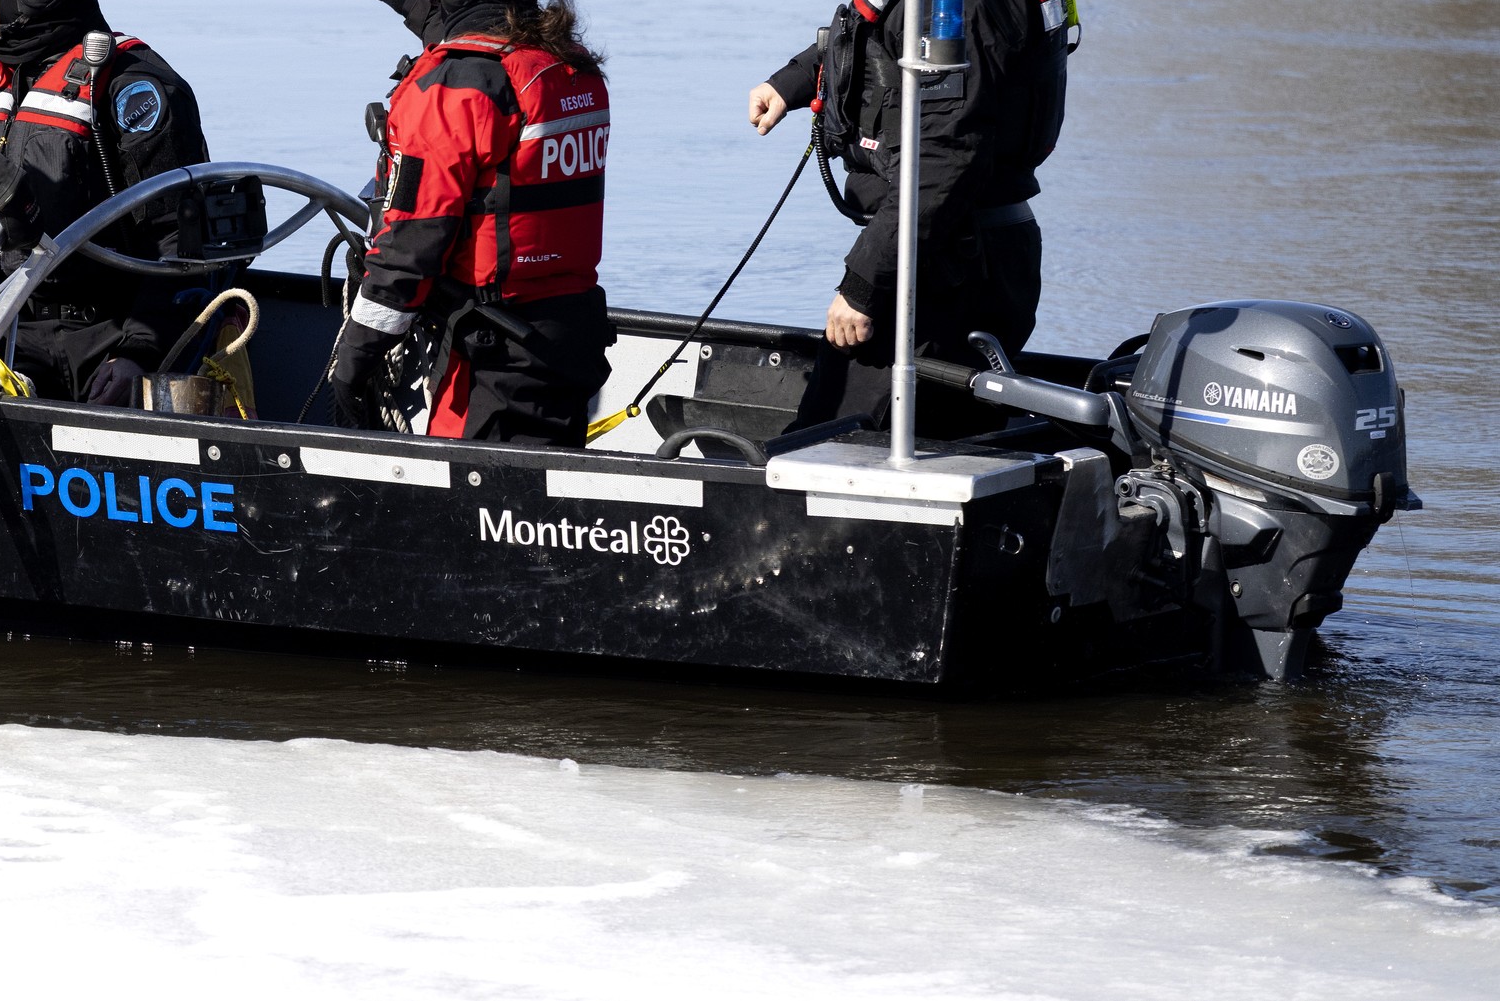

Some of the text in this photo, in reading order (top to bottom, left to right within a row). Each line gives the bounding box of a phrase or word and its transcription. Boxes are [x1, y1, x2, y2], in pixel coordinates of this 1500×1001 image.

[124, 96, 156, 125] POLICE
[560, 92, 595, 112] RESCUE
[517, 254, 550, 263] SALUS
[1223, 385, 1297, 416] YAMAHA
[1355, 406, 1396, 431] 25
[19, 463, 238, 533] POLICE
[479, 507, 638, 555] Montréal
